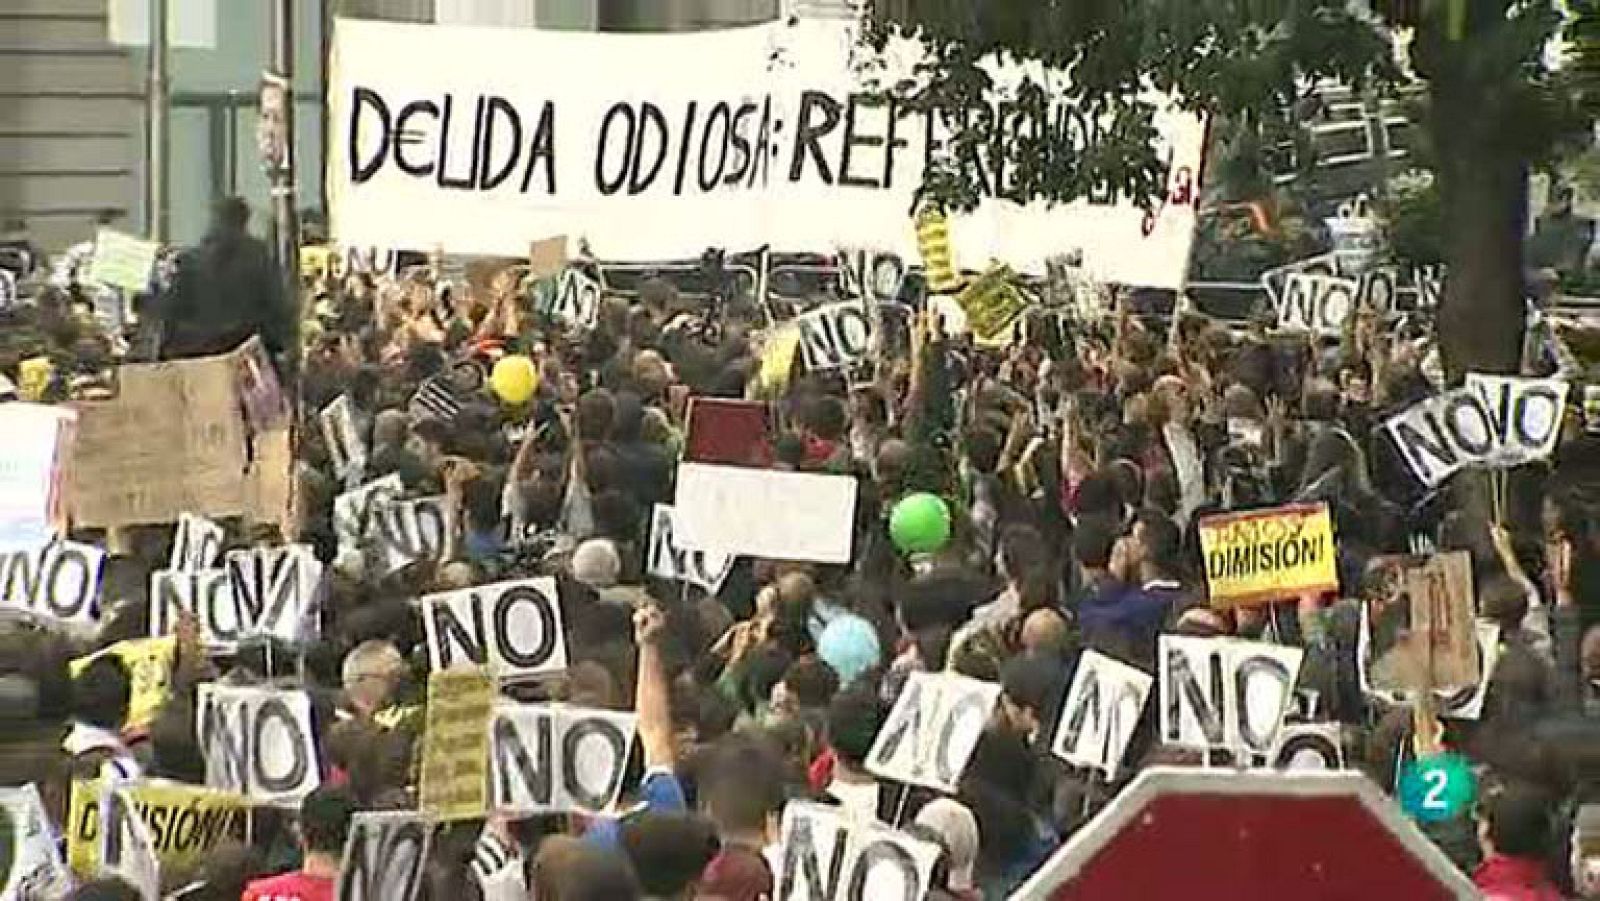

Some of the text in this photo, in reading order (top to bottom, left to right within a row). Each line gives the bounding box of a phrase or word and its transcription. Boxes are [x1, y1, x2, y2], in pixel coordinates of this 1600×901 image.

[800, 306, 871, 371] NO
[1393, 393, 1494, 480] NO
[2, 544, 91, 618] NO
[431, 585, 556, 668] NO
[204, 691, 308, 791] NO
[1168, 646, 1291, 752] NO
[494, 715, 627, 810] NO
[779, 815, 921, 901] NO
